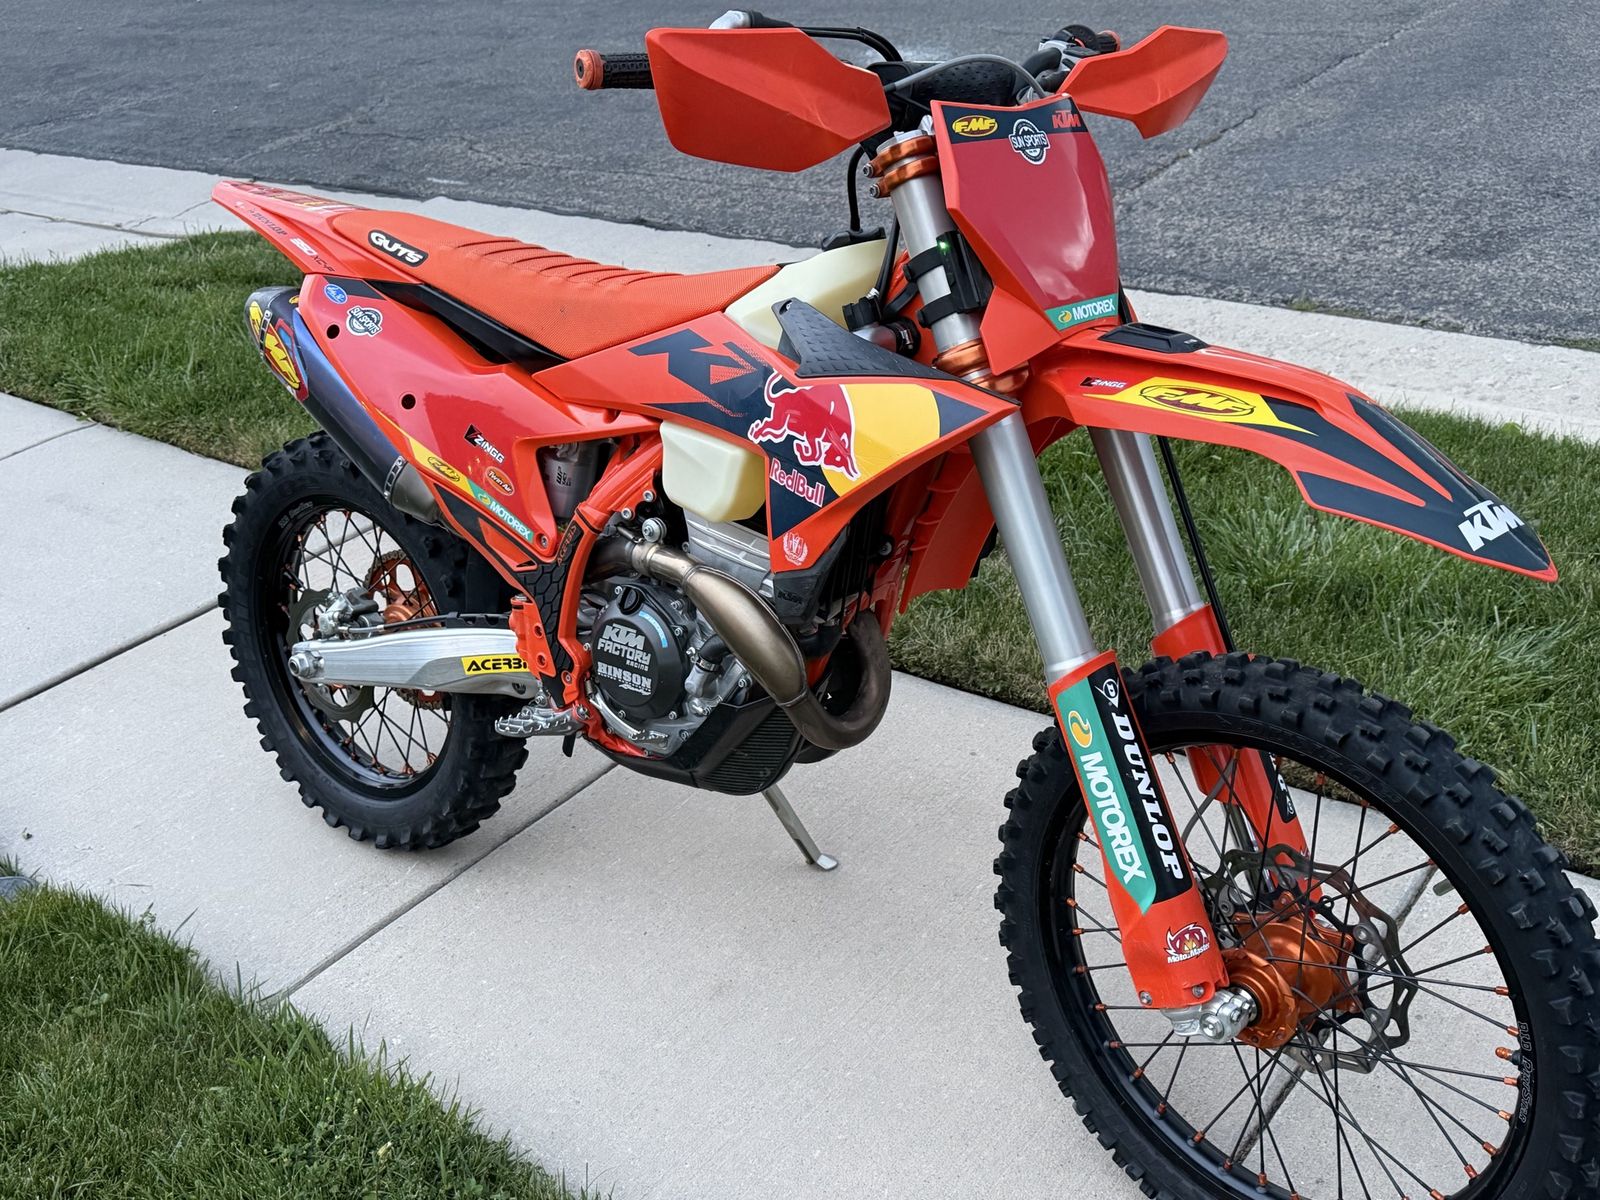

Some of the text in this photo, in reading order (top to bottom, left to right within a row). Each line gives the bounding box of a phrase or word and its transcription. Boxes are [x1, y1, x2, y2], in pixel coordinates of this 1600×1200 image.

[953, 116, 997, 134] FMF
[1052, 110, 1081, 128] KTM
[1011, 133, 1048, 149] SUN SPORTS
[370, 232, 424, 264] GUTS
[1072, 298, 1116, 321] MOTOREX
[359, 314, 381, 334] SPORTS
[1091, 378, 1128, 389] ZINGG
[1140, 385, 1256, 415] FMF
[474, 434, 505, 464] ZINGG
[488, 470, 514, 494] Twin Air
[489, 500, 533, 541] MOTOREX
[1458, 500, 1525, 552] KTM
[602, 623, 645, 650] KTM
[466, 656, 528, 672] ACERBI
[597, 637, 652, 666] FACTORY
[597, 661, 652, 689] HINSON
[625, 659, 650, 672] RACING
[1111, 712, 1184, 881] DUNLOP
[1080, 751, 1147, 884] MOTOREX
